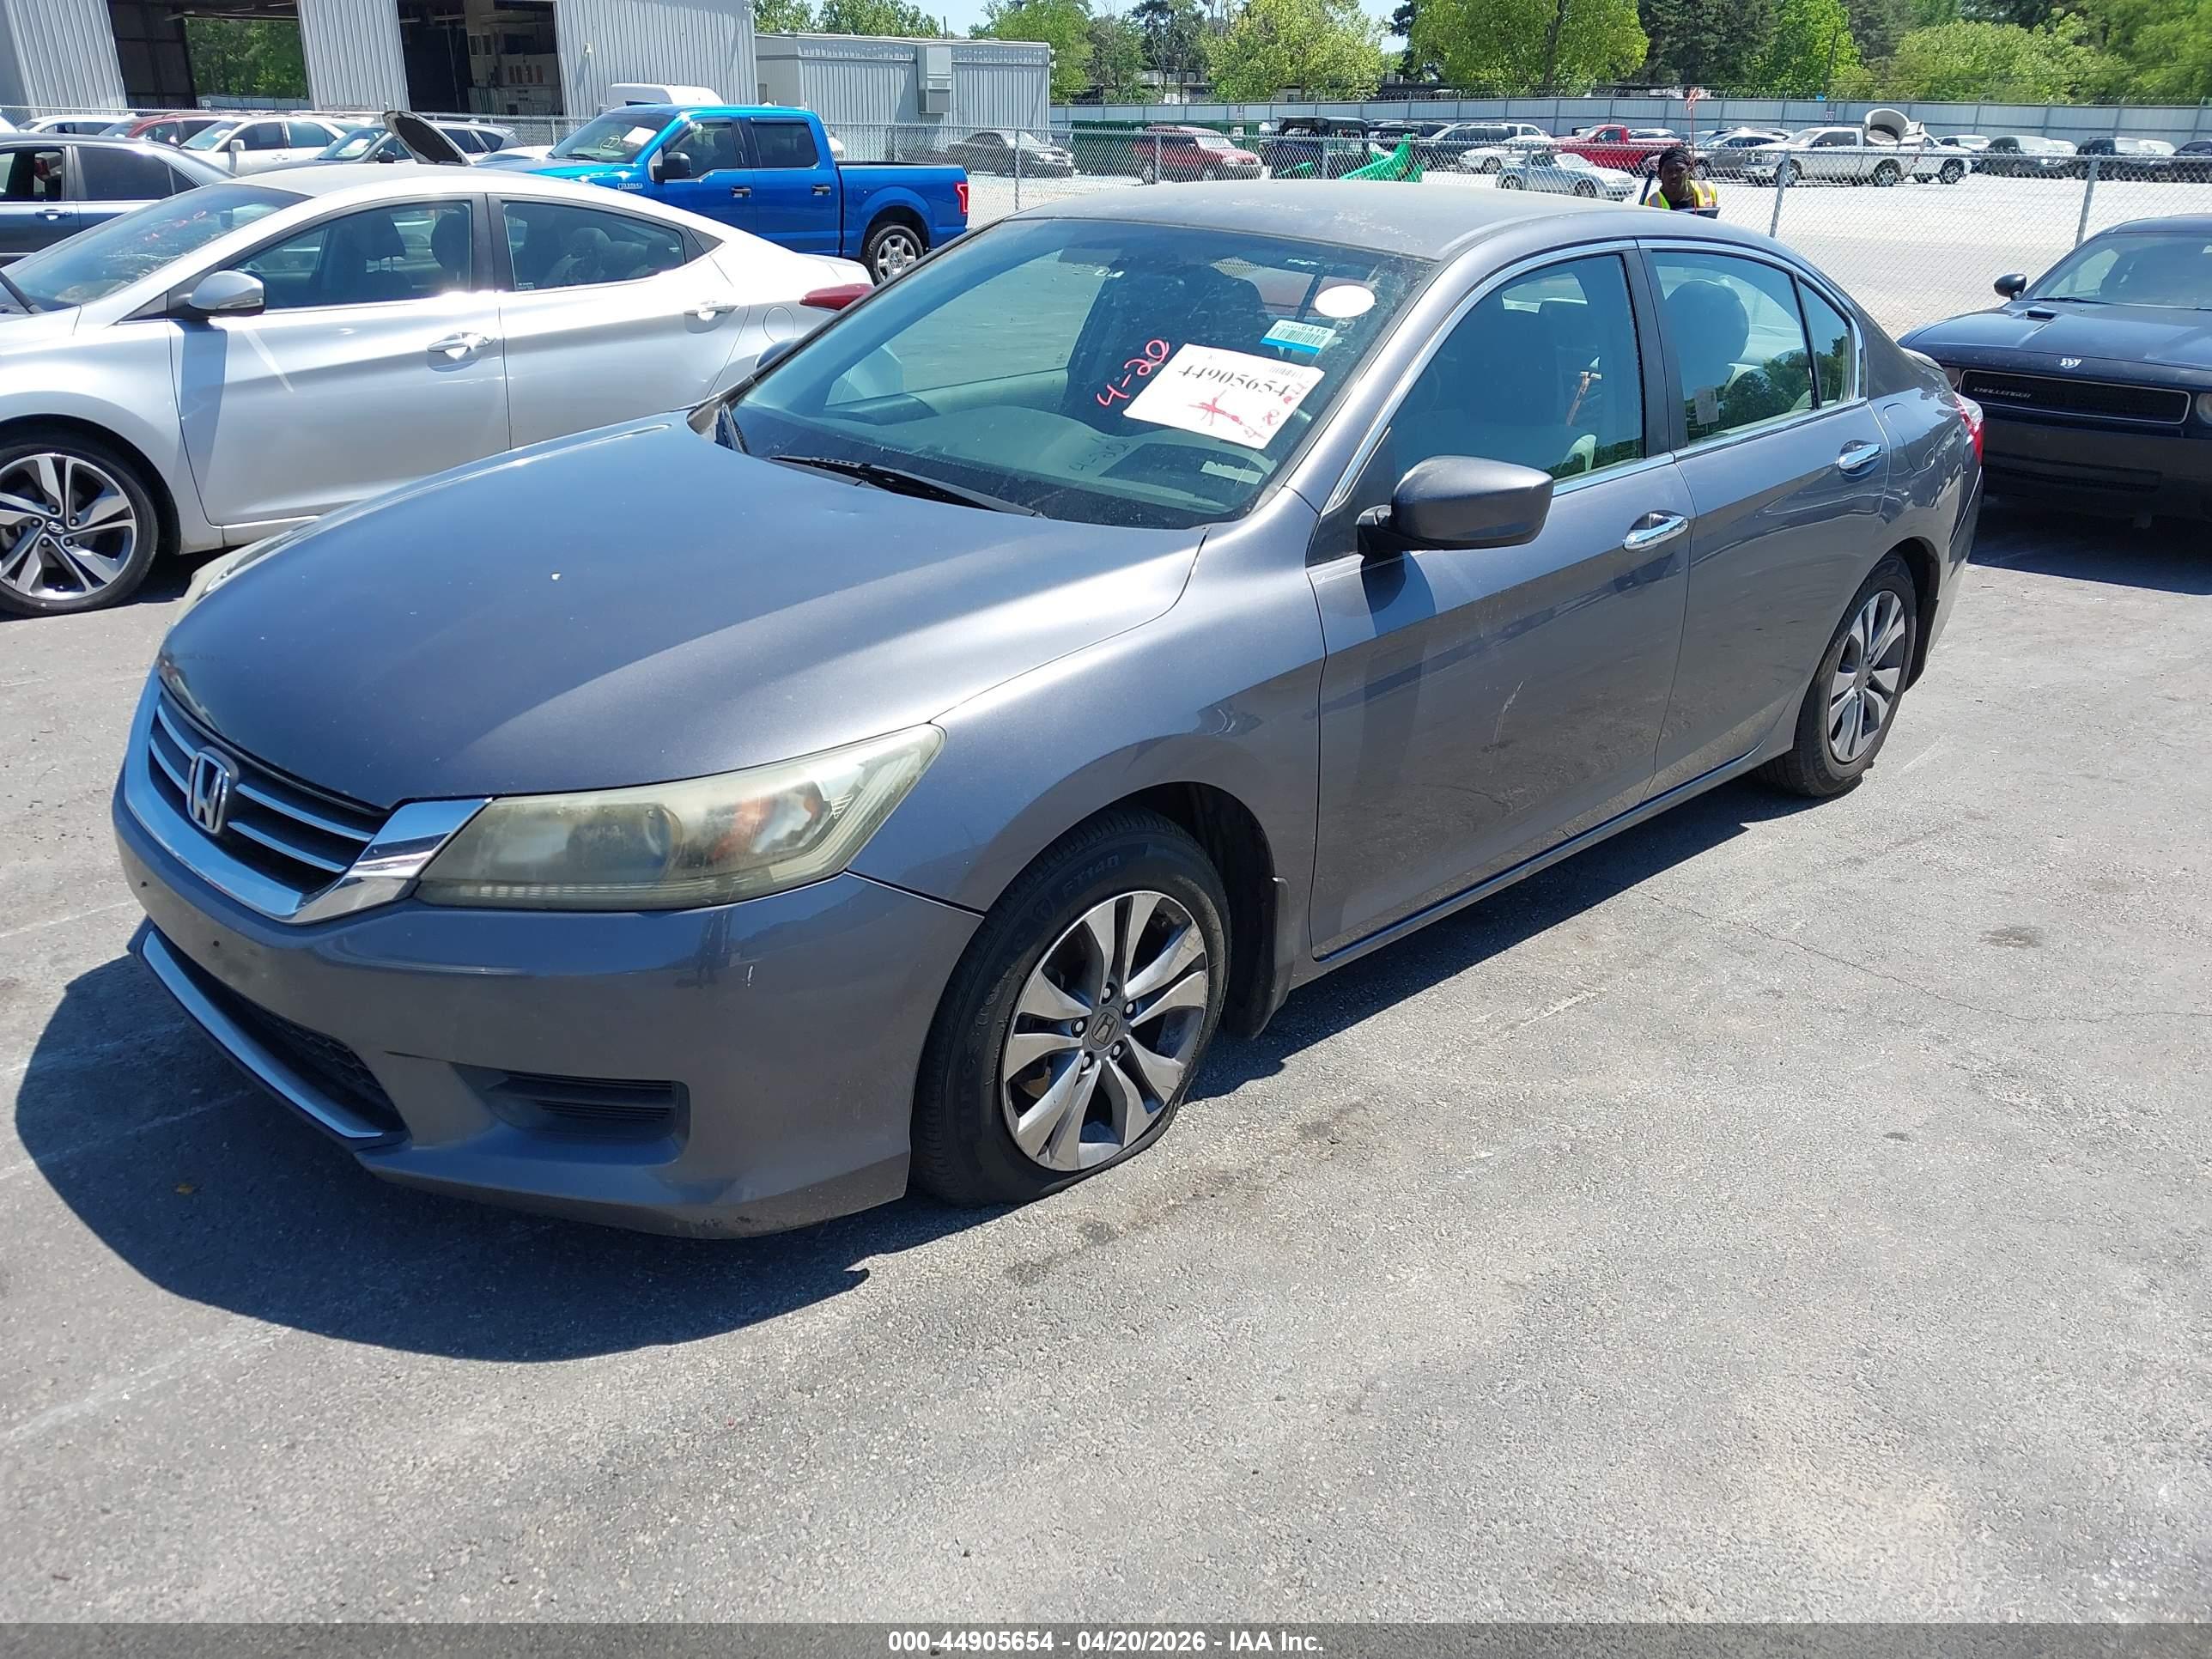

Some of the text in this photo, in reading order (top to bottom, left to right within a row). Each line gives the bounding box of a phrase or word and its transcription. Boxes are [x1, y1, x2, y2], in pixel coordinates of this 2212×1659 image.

[1097, 340, 1170, 406] 4-20
[1177, 364, 1291, 398] 44905654
[1973, 387, 2032, 398] CHALLENGER
